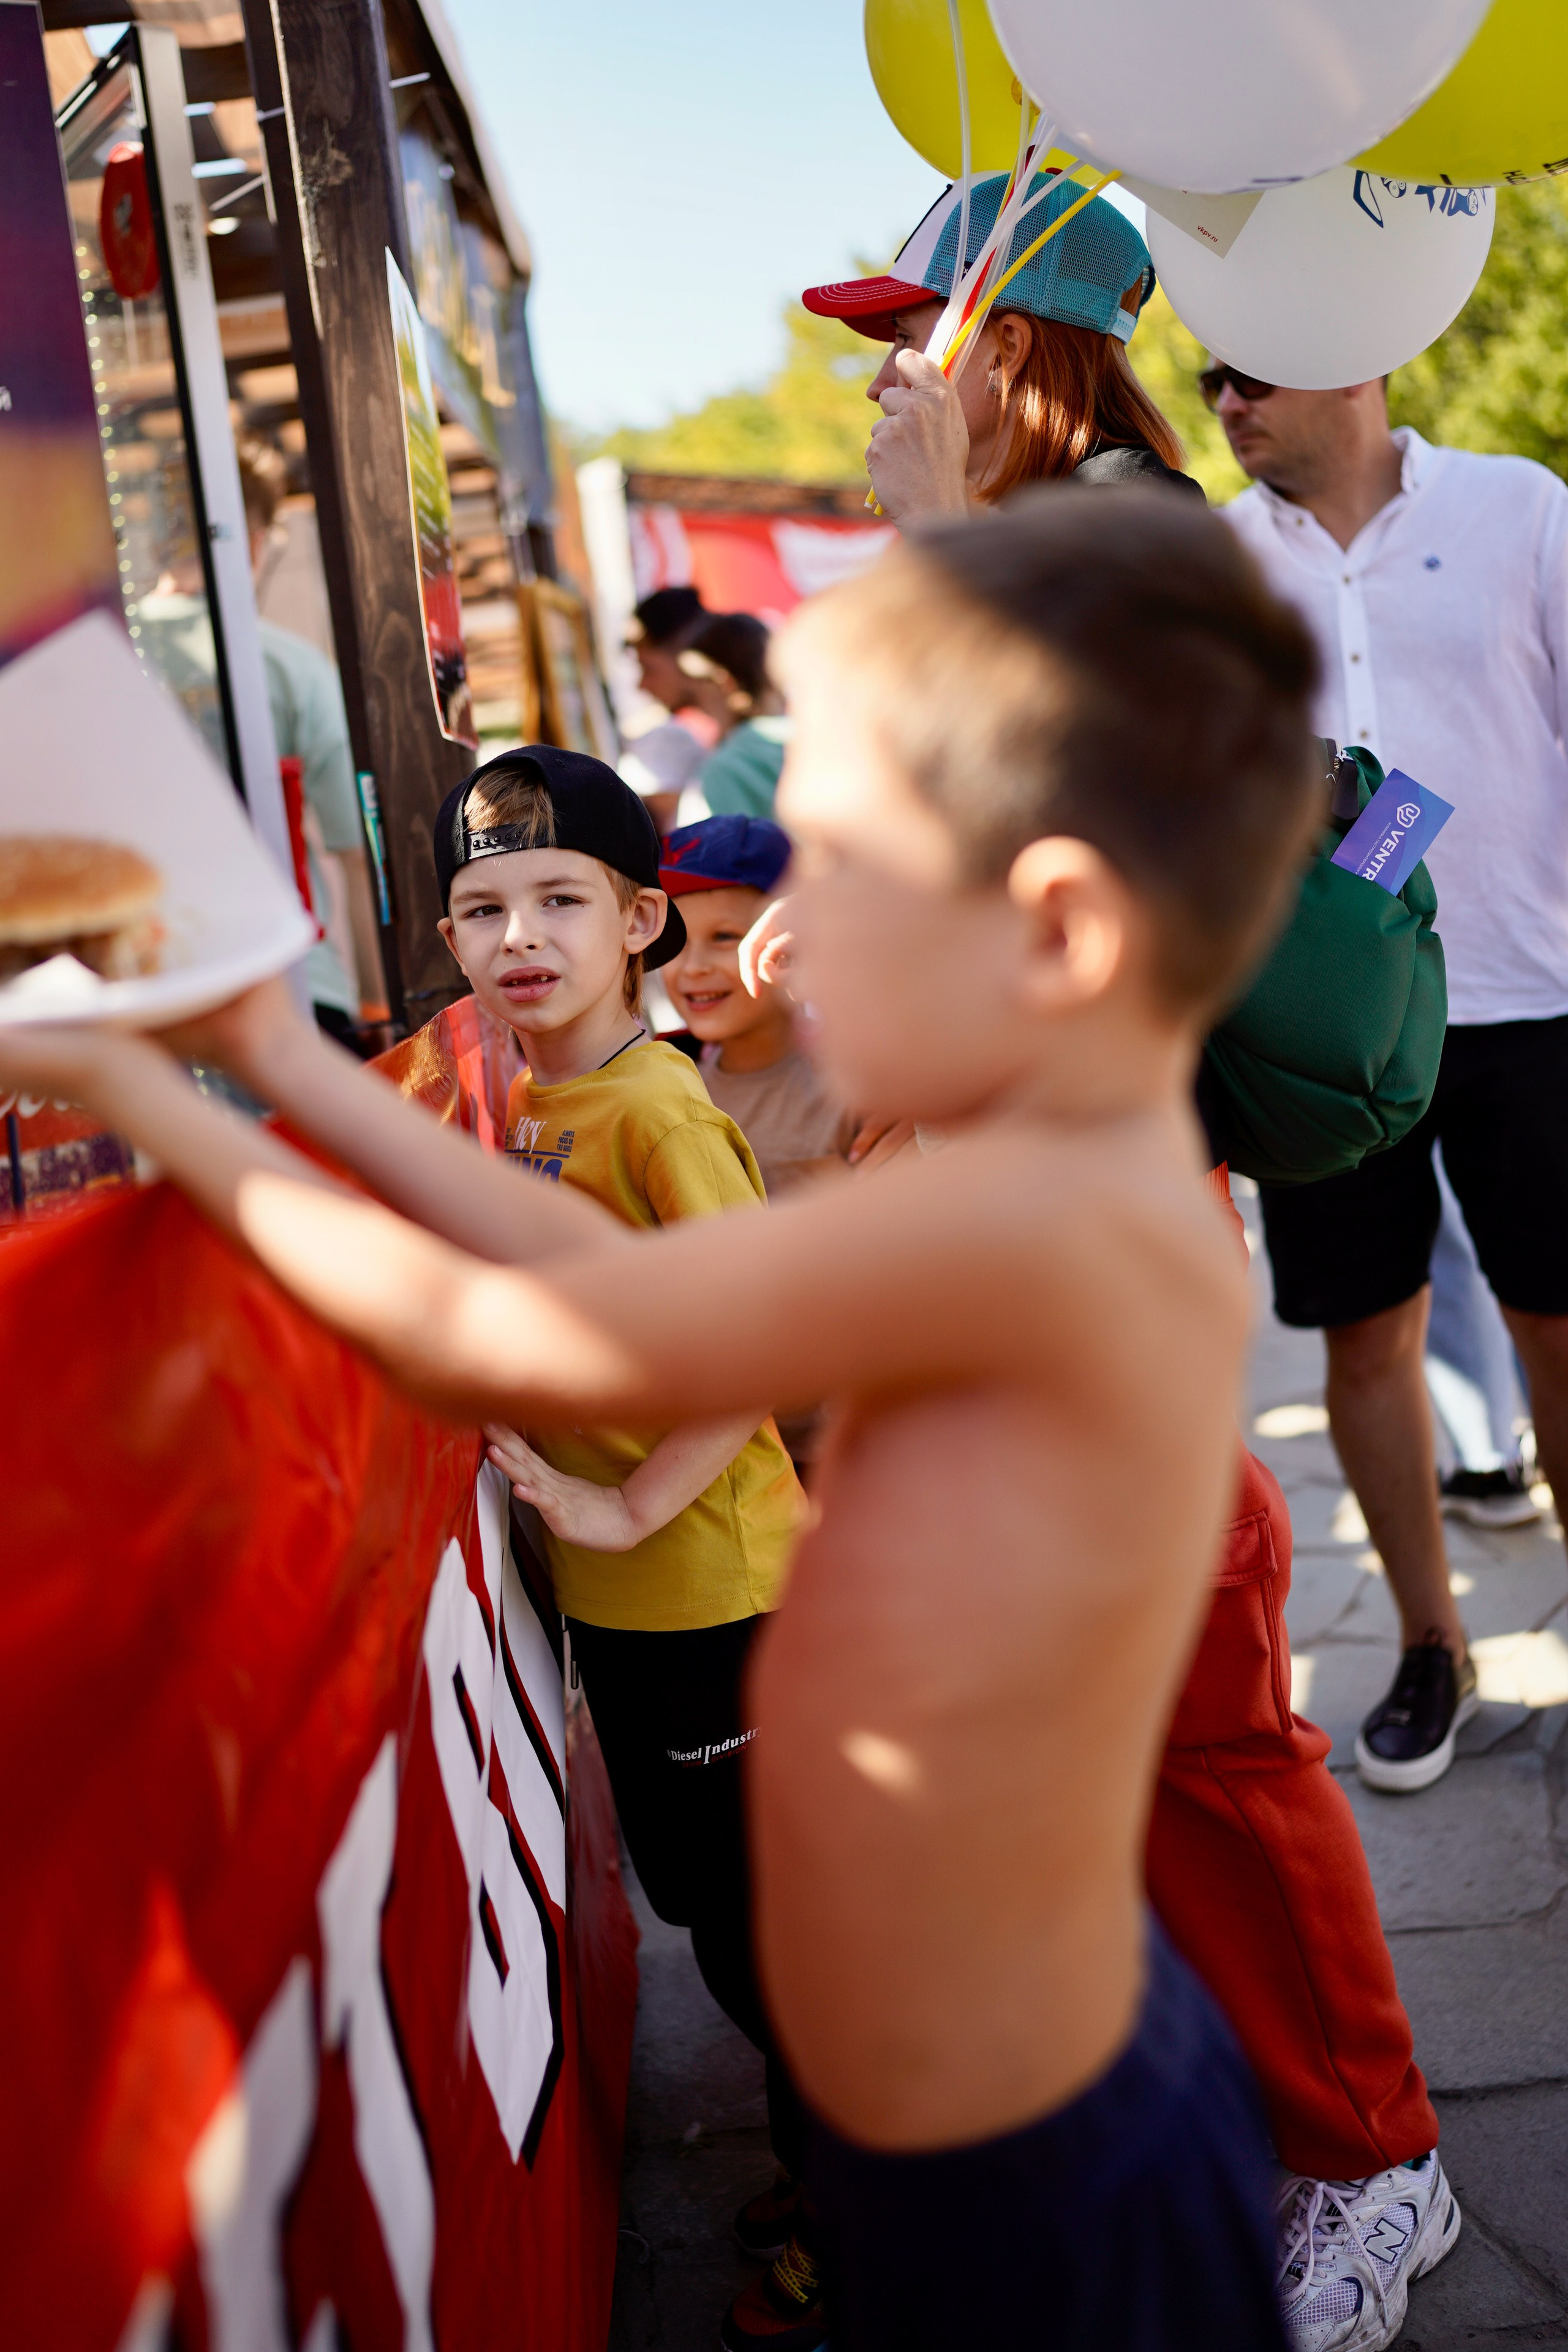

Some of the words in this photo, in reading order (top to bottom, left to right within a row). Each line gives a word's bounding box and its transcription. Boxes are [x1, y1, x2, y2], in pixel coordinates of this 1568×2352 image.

[1197, 225, 1218, 242] vkpv.ru
[671, 1747, 702, 1761] Diesel
[703, 1727, 761, 1764] Industr
[712, 1744, 747, 1762] DIVISION
